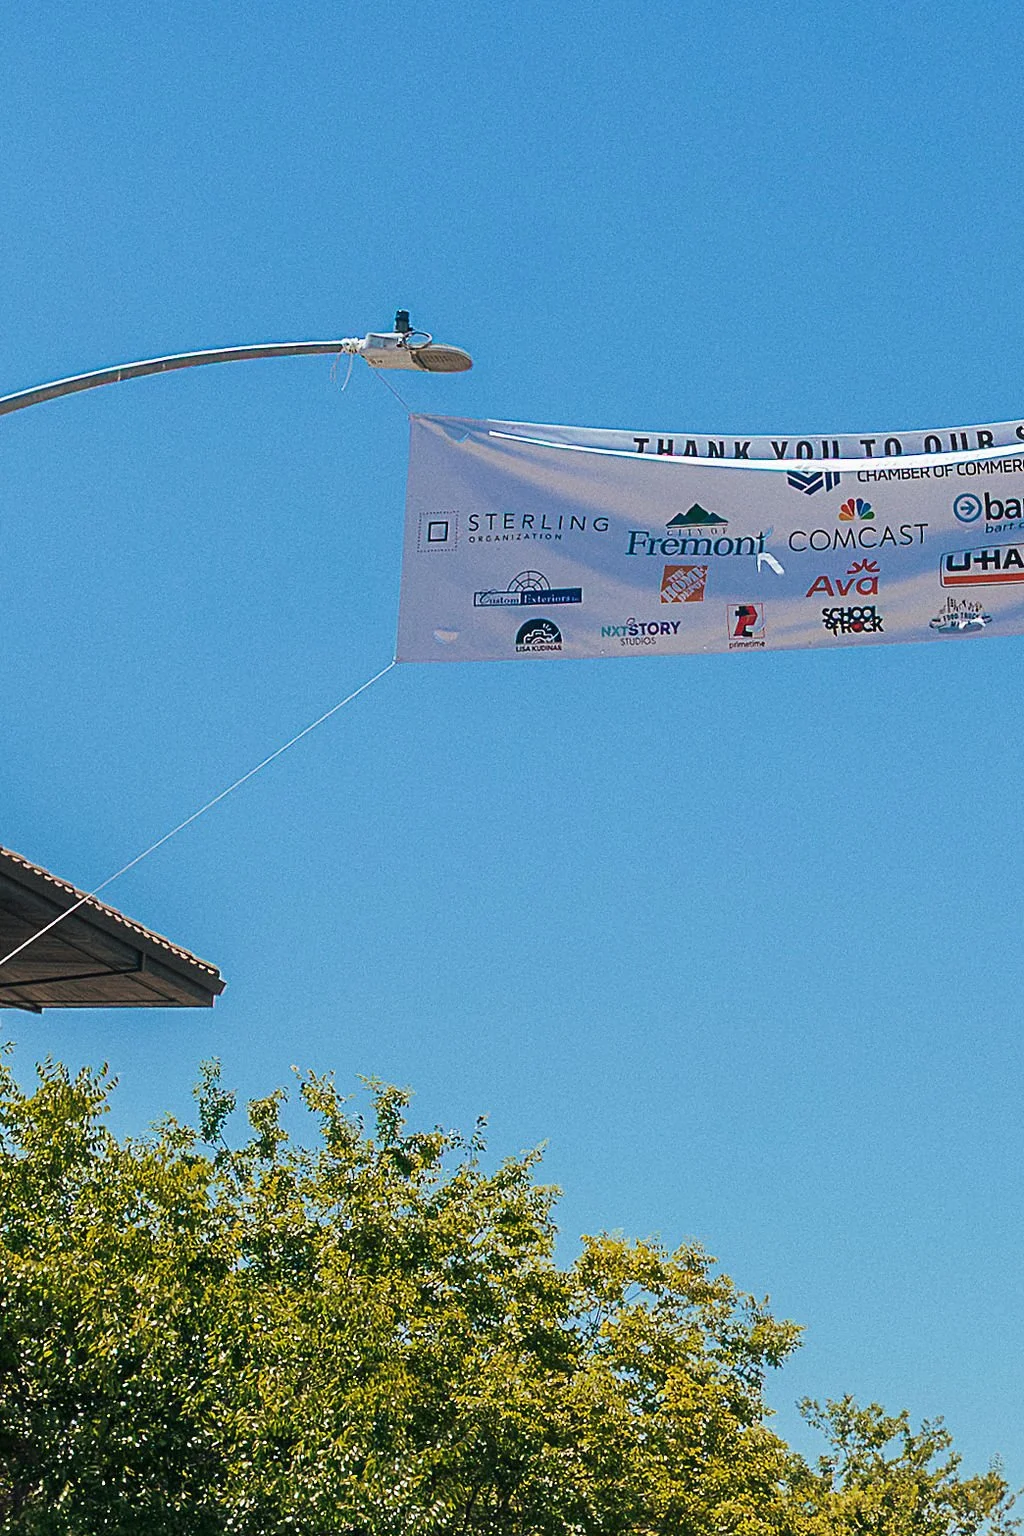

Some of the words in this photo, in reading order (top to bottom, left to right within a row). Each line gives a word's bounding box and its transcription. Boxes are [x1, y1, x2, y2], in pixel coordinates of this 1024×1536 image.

[633, 437, 752, 460] THANK
[770, 440, 840, 460] YOU
[859, 437, 903, 458] TO
[924, 430, 996, 455] OUR
[857, 467, 930, 483] CHAMBER
[933, 463, 954, 478] OF
[468, 513, 610, 532] STERLING
[666, 528, 703, 537] CITY
[710, 526, 728, 535] OF
[468, 533, 563, 544] ORGANIZATION
[625, 530, 766, 557] Fremont
[789, 523, 929, 552] COMCAST
[805, 575, 879, 598] Ava
[821, 604, 877, 622] SCHOOL
[620, 637, 657, 646] STUDIOS
